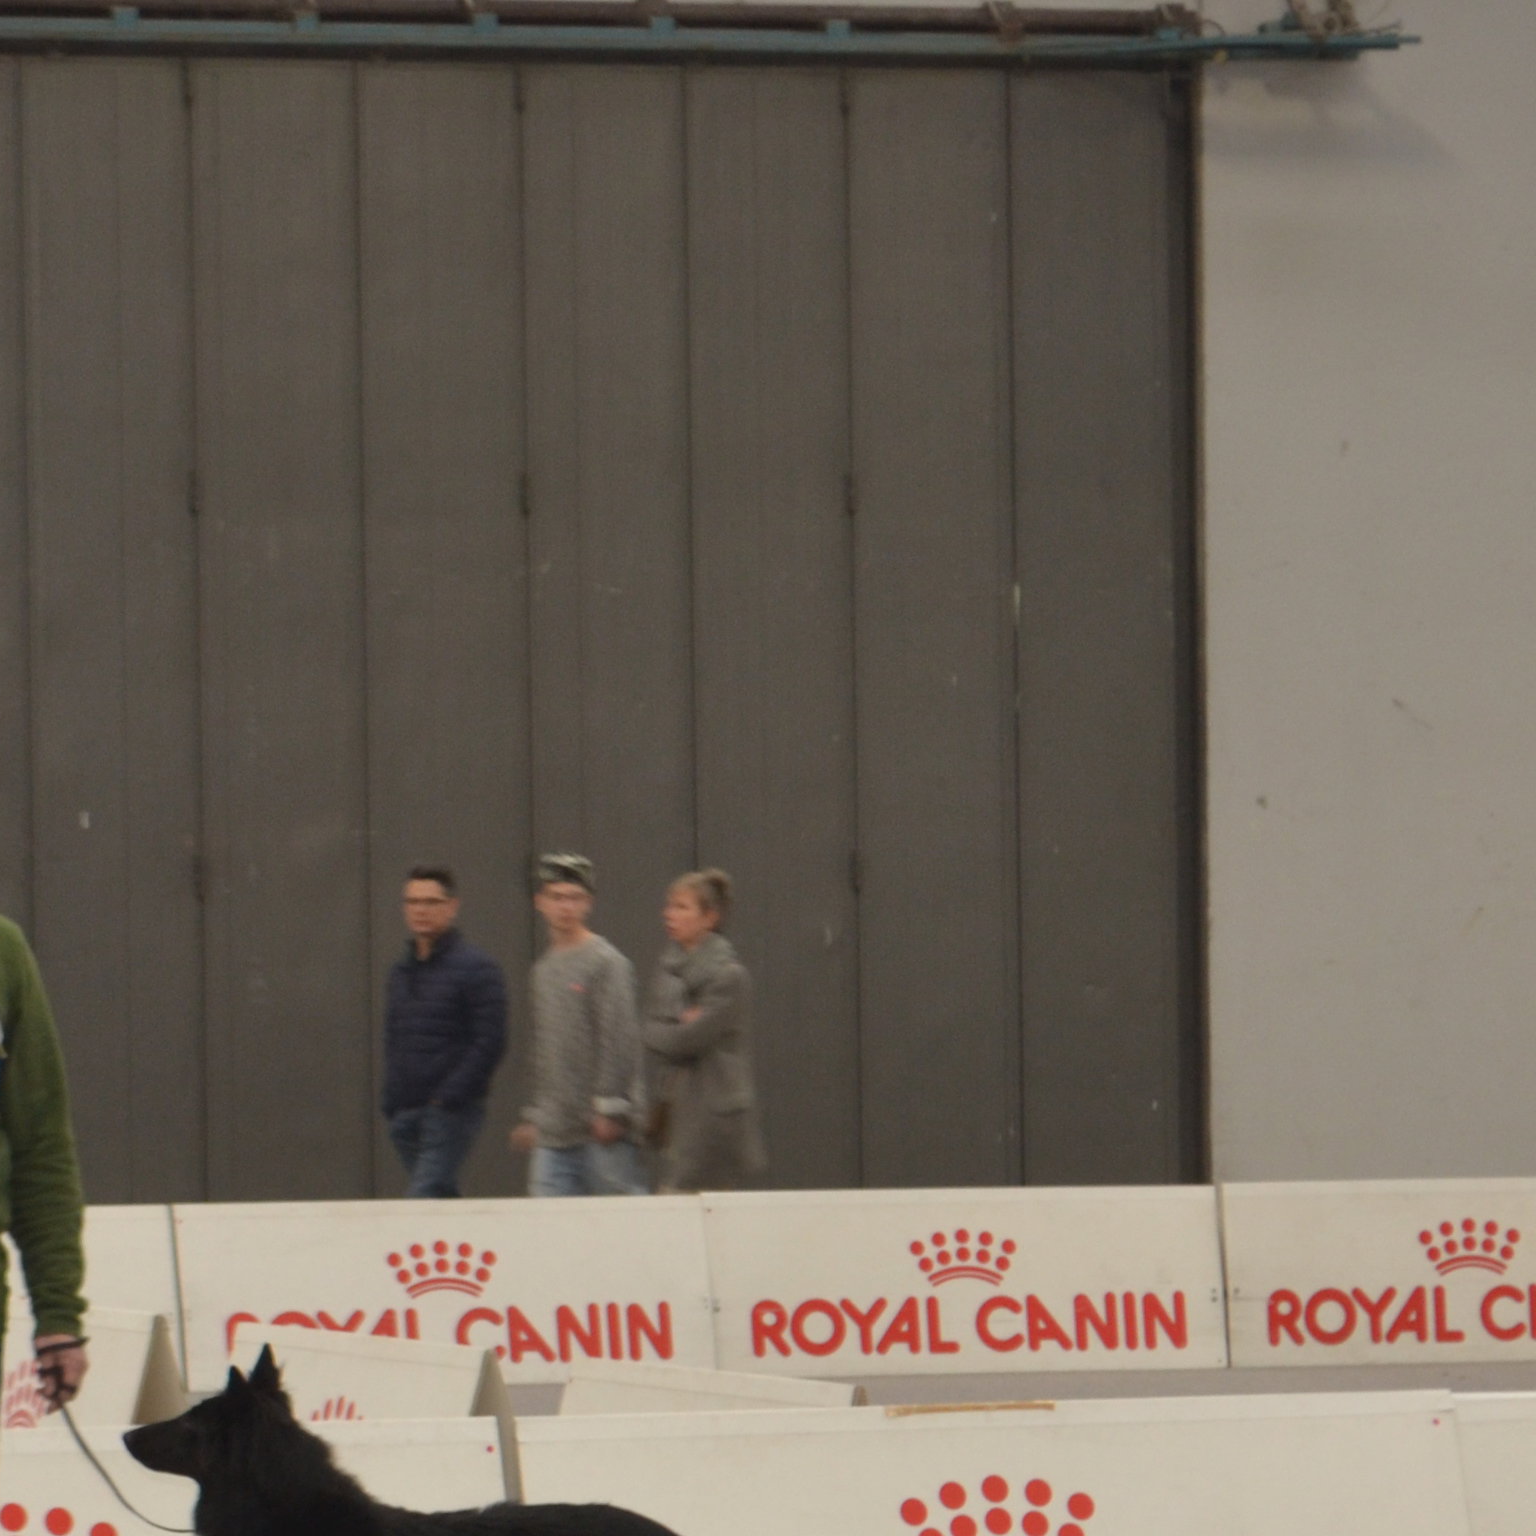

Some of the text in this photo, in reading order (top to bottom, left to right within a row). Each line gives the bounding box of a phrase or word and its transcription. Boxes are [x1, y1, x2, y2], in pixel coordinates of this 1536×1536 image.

[455, 1299, 676, 1365] CANIN
[749, 1288, 1190, 1359] ROYAL CANIN
[1266, 1283, 1467, 1348] ROYAL
